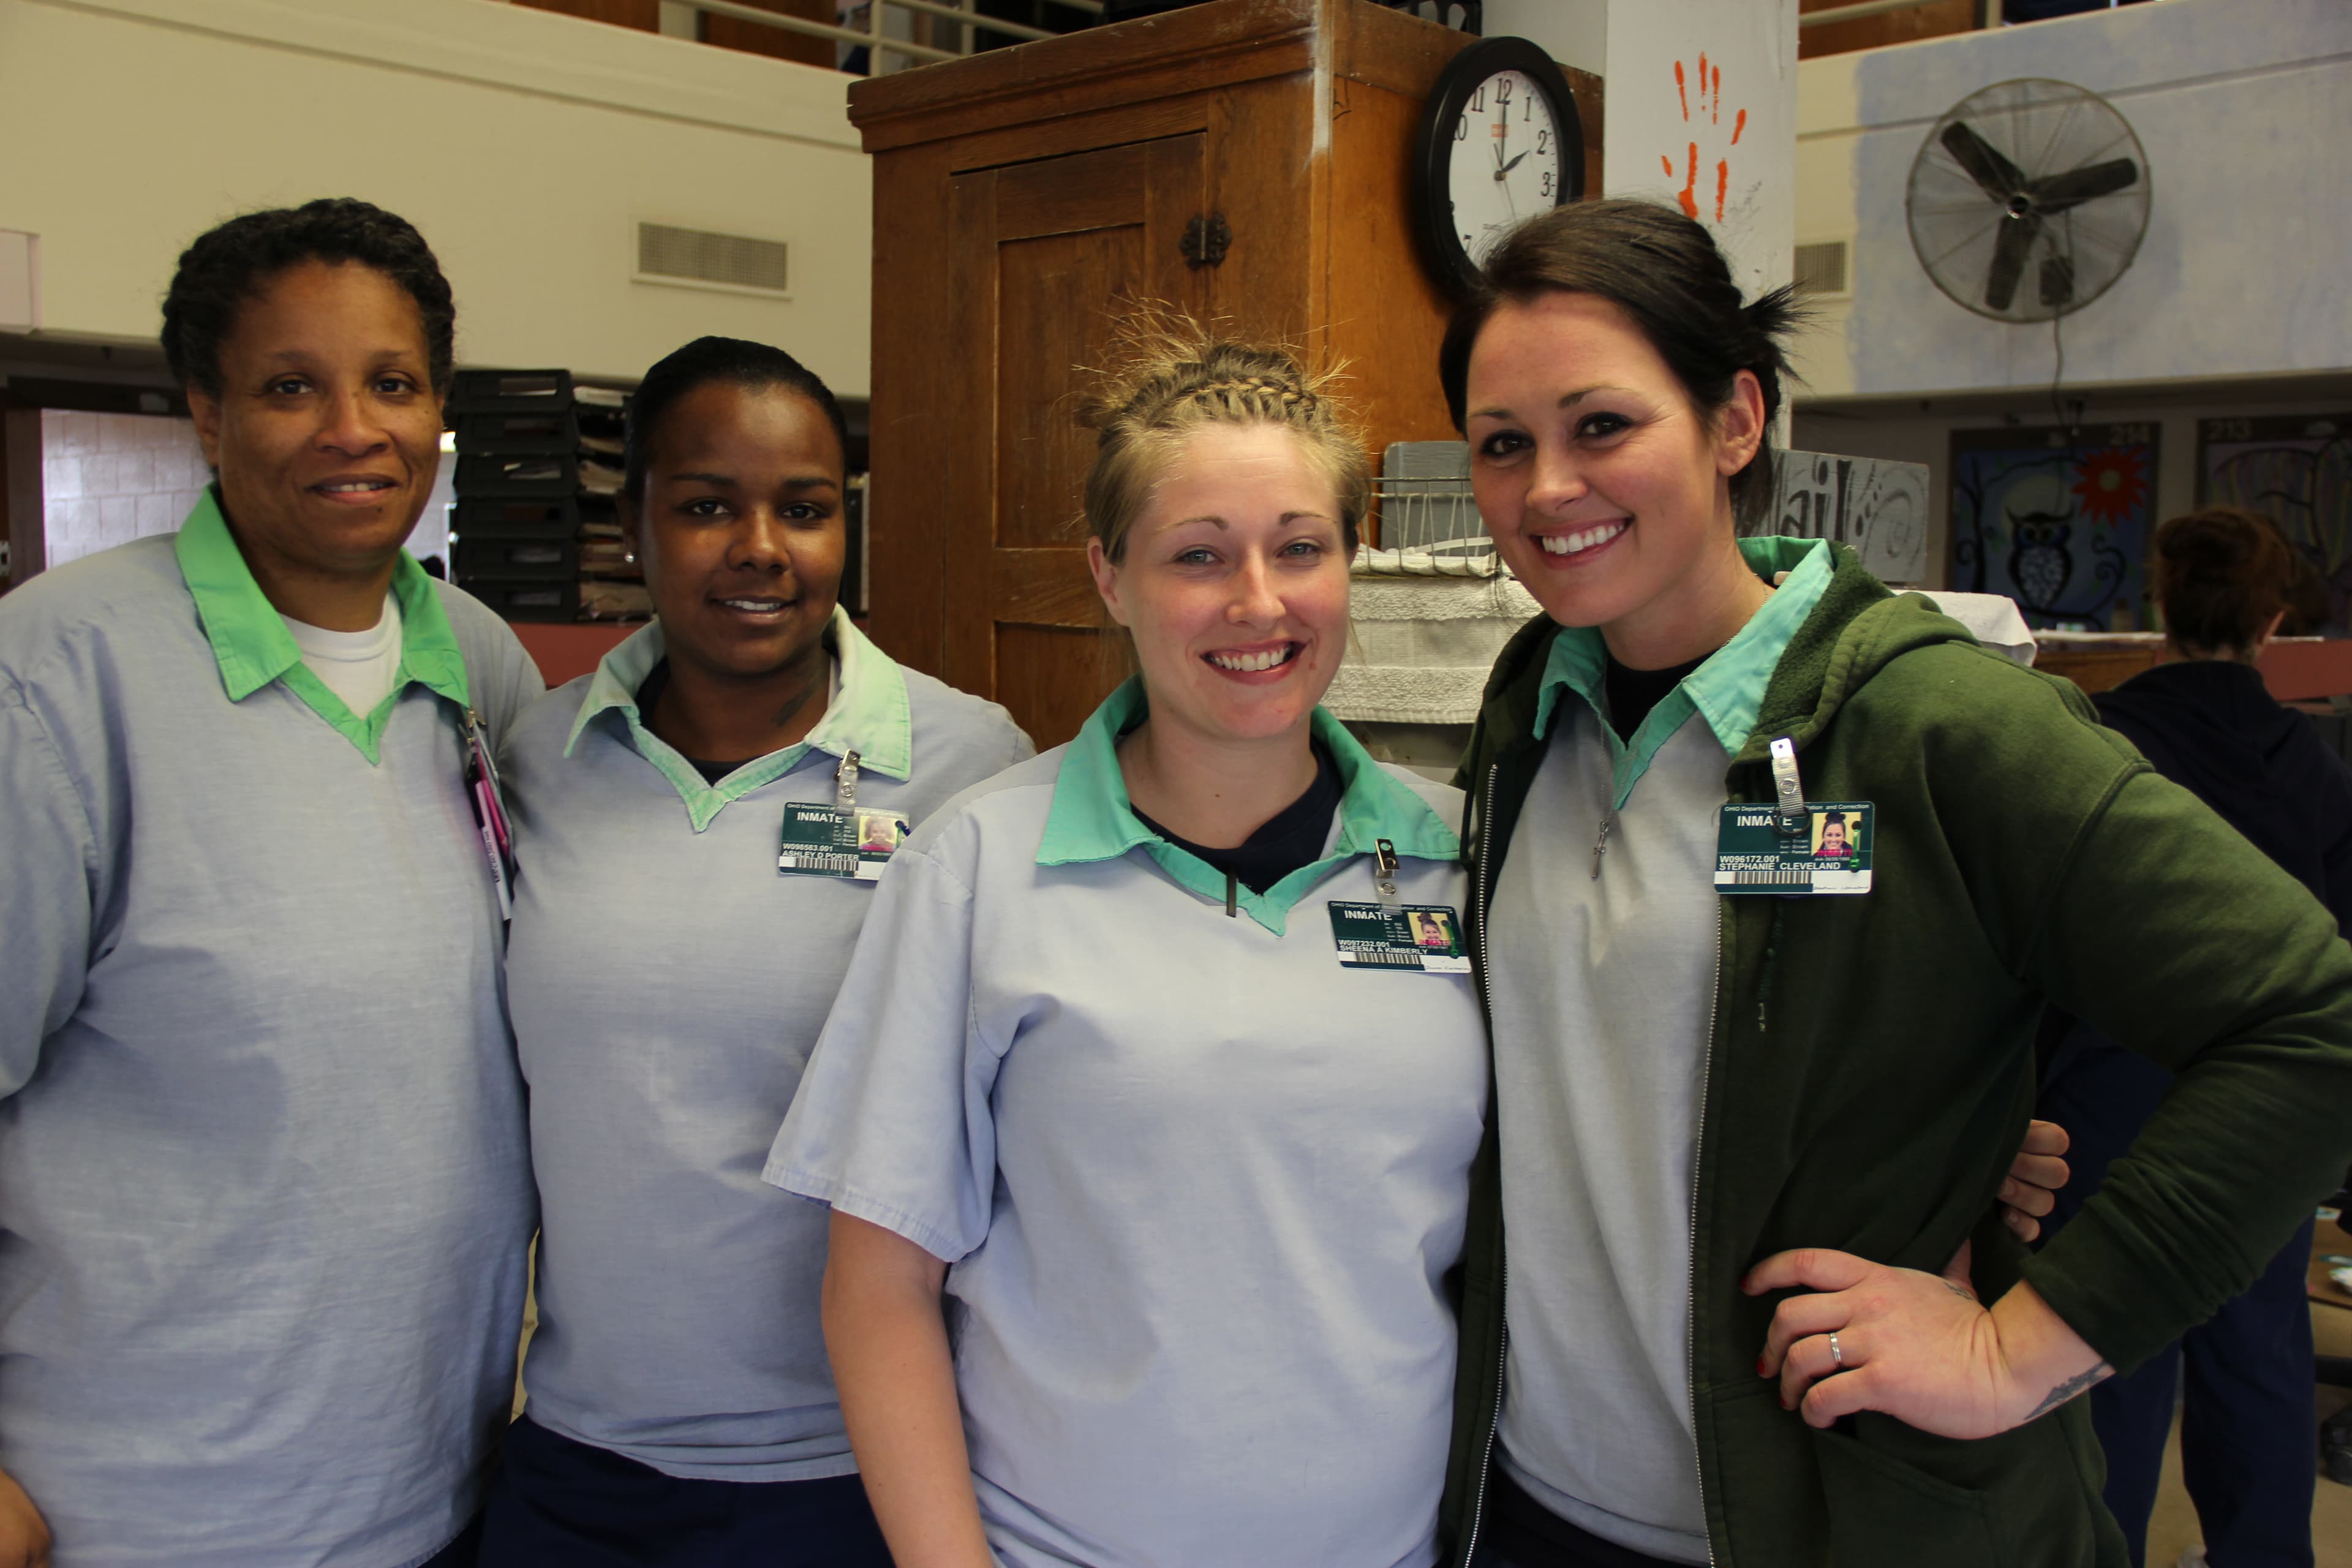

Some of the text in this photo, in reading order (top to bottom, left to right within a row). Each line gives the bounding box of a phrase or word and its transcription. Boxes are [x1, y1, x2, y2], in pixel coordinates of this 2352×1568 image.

[1471, 86, 1485, 113] 11
[1494, 78, 1513, 105] 12
[1523, 96, 1531, 122] 1
[1453, 115, 1468, 141] 0
[1536, 129, 1548, 155] 2
[1540, 172, 1550, 197] 3
[797, 812, 843, 823] INMATE
[824, 852, 859, 861] PORTER
[1780, 862, 1841, 870] CLEVELAND
[1344, 910, 1392, 921] INMATE
[1338, 939, 1390, 948] W097232.001
[1385, 946, 1428, 955] KIMBERLY
